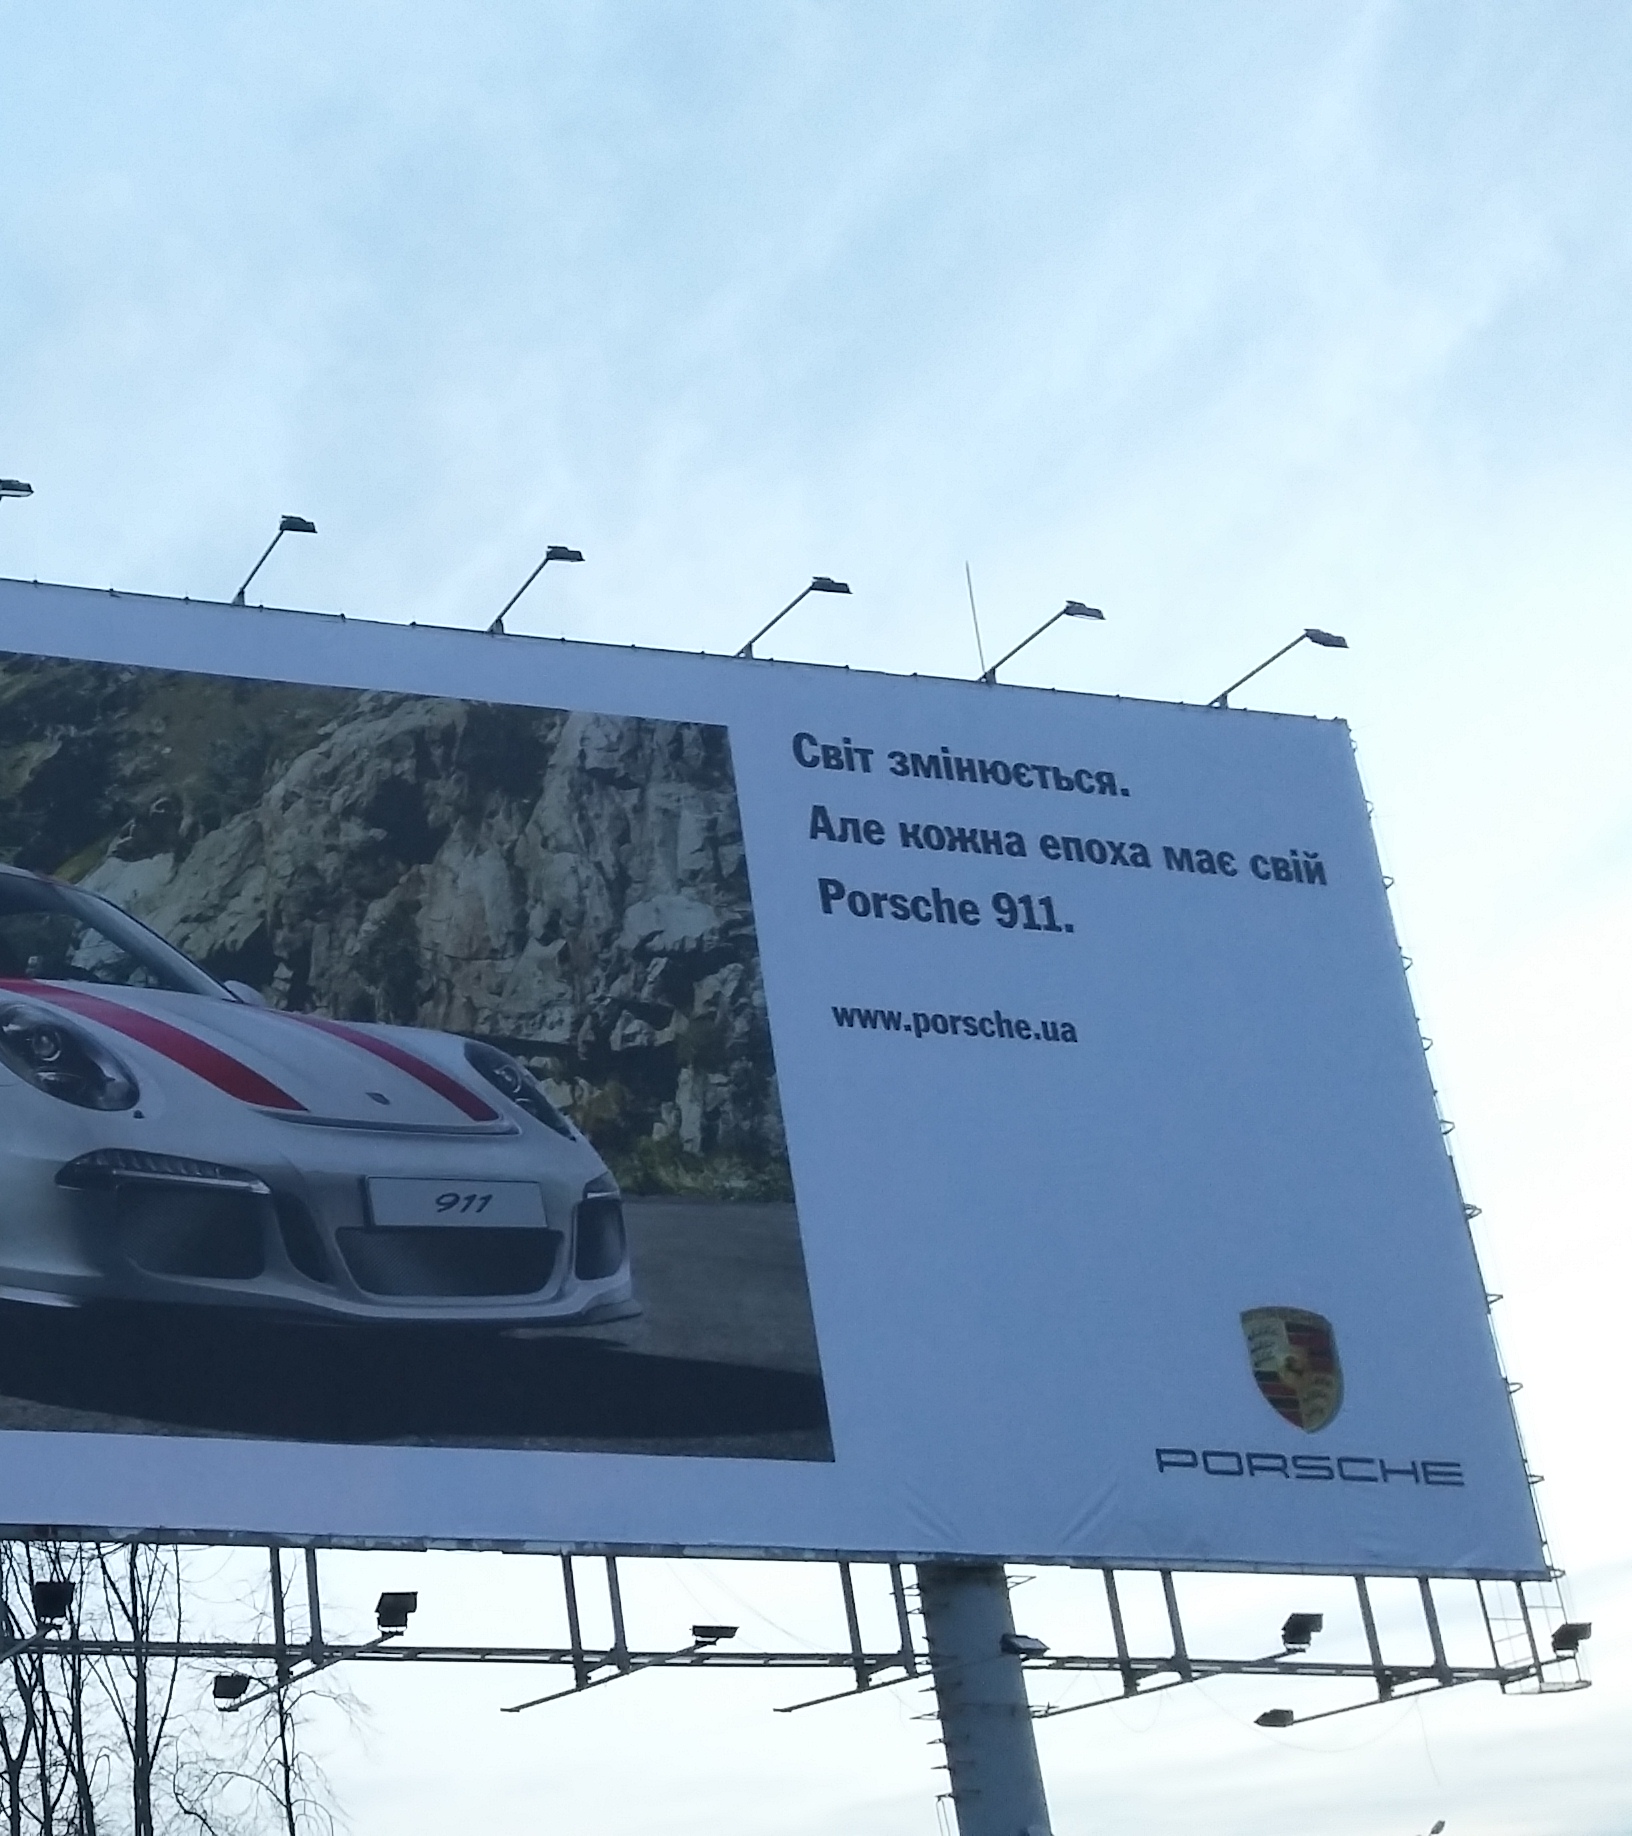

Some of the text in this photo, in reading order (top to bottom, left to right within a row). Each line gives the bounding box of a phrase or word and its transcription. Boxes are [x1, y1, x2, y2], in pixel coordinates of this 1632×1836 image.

[792, 732, 1131, 797] Світ змінюється.
[810, 805, 1328, 886] Але кожна епоха має свій
[818, 878, 1074, 933] Porsche 911.
[831, 1005, 1078, 1043] www.porsche.ua
[435, 1192, 493, 1213] 911
[1155, 1449, 1464, 1486] PORSCHE
